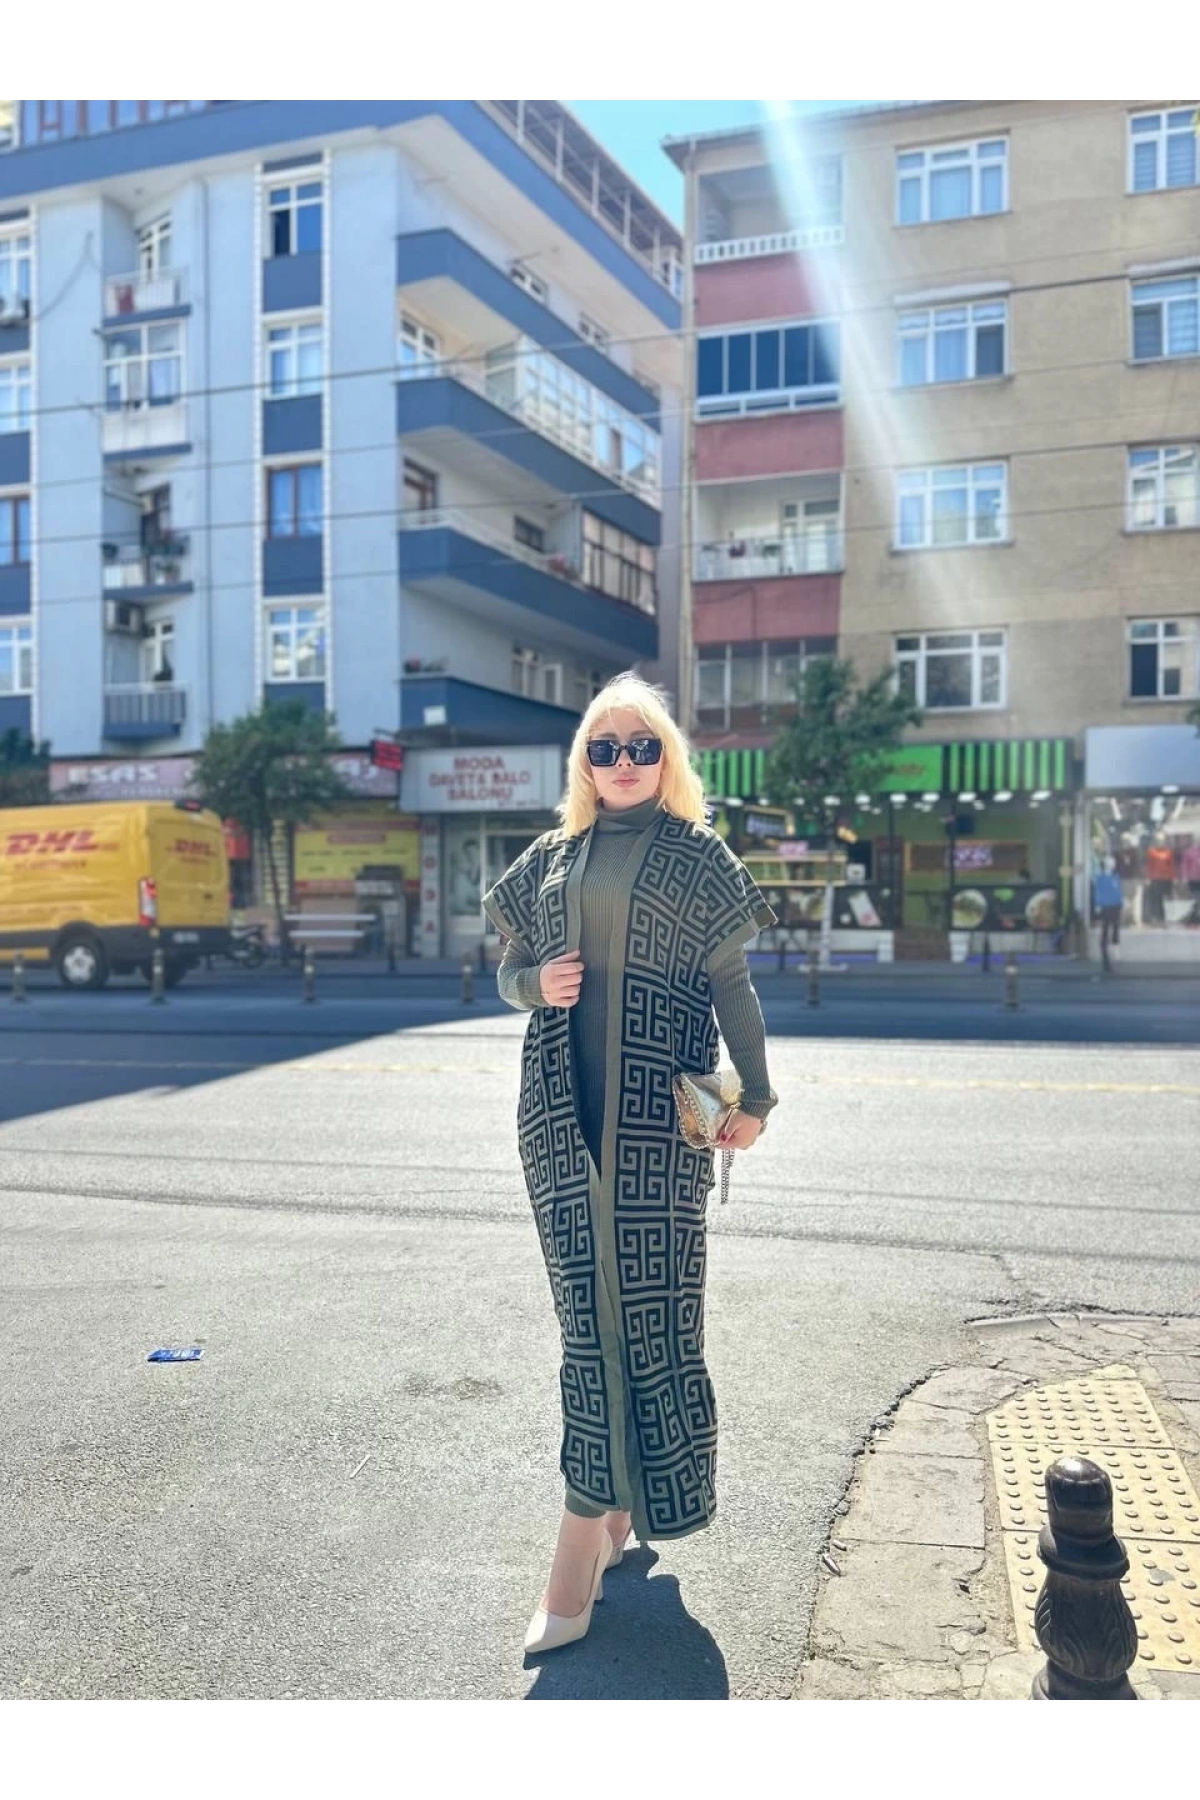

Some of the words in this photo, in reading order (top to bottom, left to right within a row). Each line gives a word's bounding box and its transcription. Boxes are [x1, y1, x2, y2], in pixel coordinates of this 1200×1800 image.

[454, 755, 504, 769] MODA
[447, 786, 513, 800] SALONU
[5, 829, 99, 856] DHL
